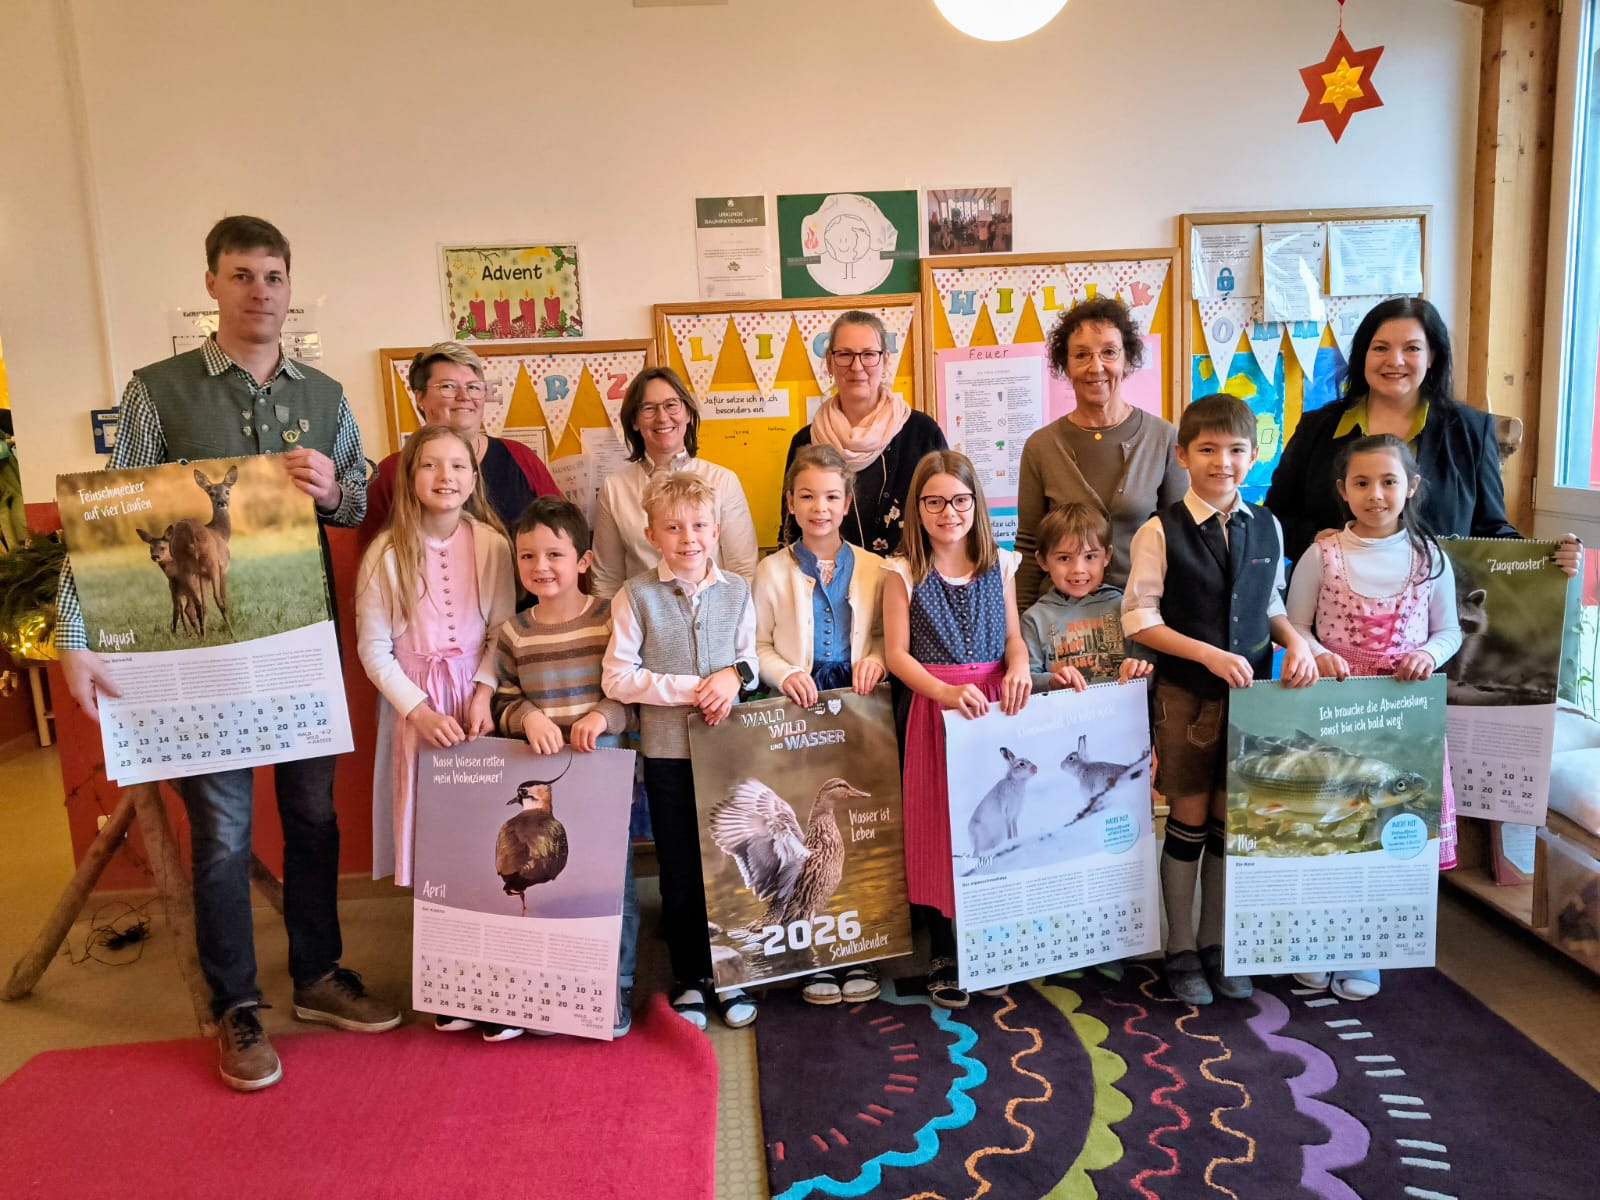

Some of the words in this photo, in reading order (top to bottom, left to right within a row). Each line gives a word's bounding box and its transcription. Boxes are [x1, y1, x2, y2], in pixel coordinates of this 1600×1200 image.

[482, 263, 543, 281] Advent
[968, 347, 1010, 360] Feuer
[78, 481, 145, 505] Feinschmecker
[84, 505, 100, 521] auf
[101, 505, 118, 518] vier
[98, 629, 135, 650] August
[1319, 707, 1333, 721] Ich
[1335, 702, 1365, 718] brauche
[1366, 699, 1379, 714] die
[1380, 694, 1428, 711] Abwechslung
[741, 708, 785, 728] WALD
[1320, 722, 1340, 737] sonst
[1341, 721, 1353, 734] bin
[1354, 719, 1366, 732] ich
[1367, 715, 1385, 731] bald
[1386, 712, 1404, 729] weg!
[768, 719, 807, 738] WILD
[770, 742, 784, 750] UND
[784, 730, 846, 758] WASSER
[432, 754, 453, 768] Nasse
[455, 754, 482, 768] Wiesen
[483, 754, 505, 768] retten
[433, 772, 451, 784] mein
[452, 770, 503, 785] Wohnzimmer!
[848, 808, 879, 826] Wasser
[880, 808, 890, 821] ist
[851, 826, 876, 842] Leben
[1237, 834, 1257, 851] Mai
[422, 880, 446, 898] April
[762, 910, 862, 956] 2026
[828, 933, 889, 961] Schulkalender
